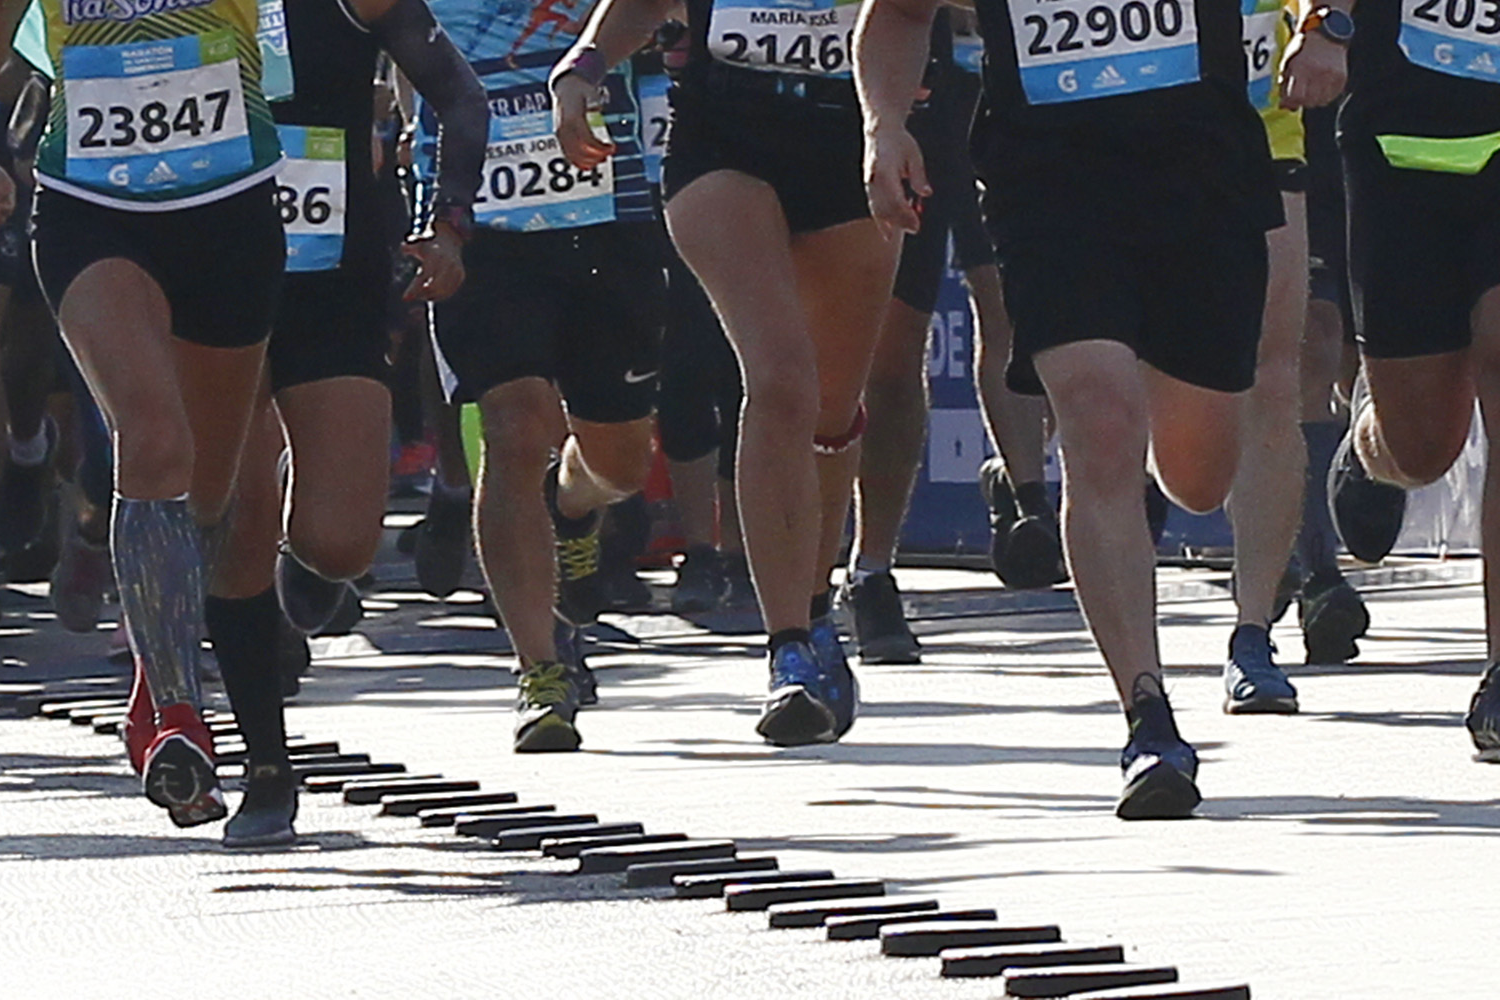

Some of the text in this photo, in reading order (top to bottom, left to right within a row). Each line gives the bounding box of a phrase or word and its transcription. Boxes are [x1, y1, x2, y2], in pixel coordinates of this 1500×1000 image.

[750, 9, 807, 24] MARÍA
[721, 29, 854, 72] 2146
[77, 89, 231, 149] 23847
[476, 157, 604, 204] 0284
